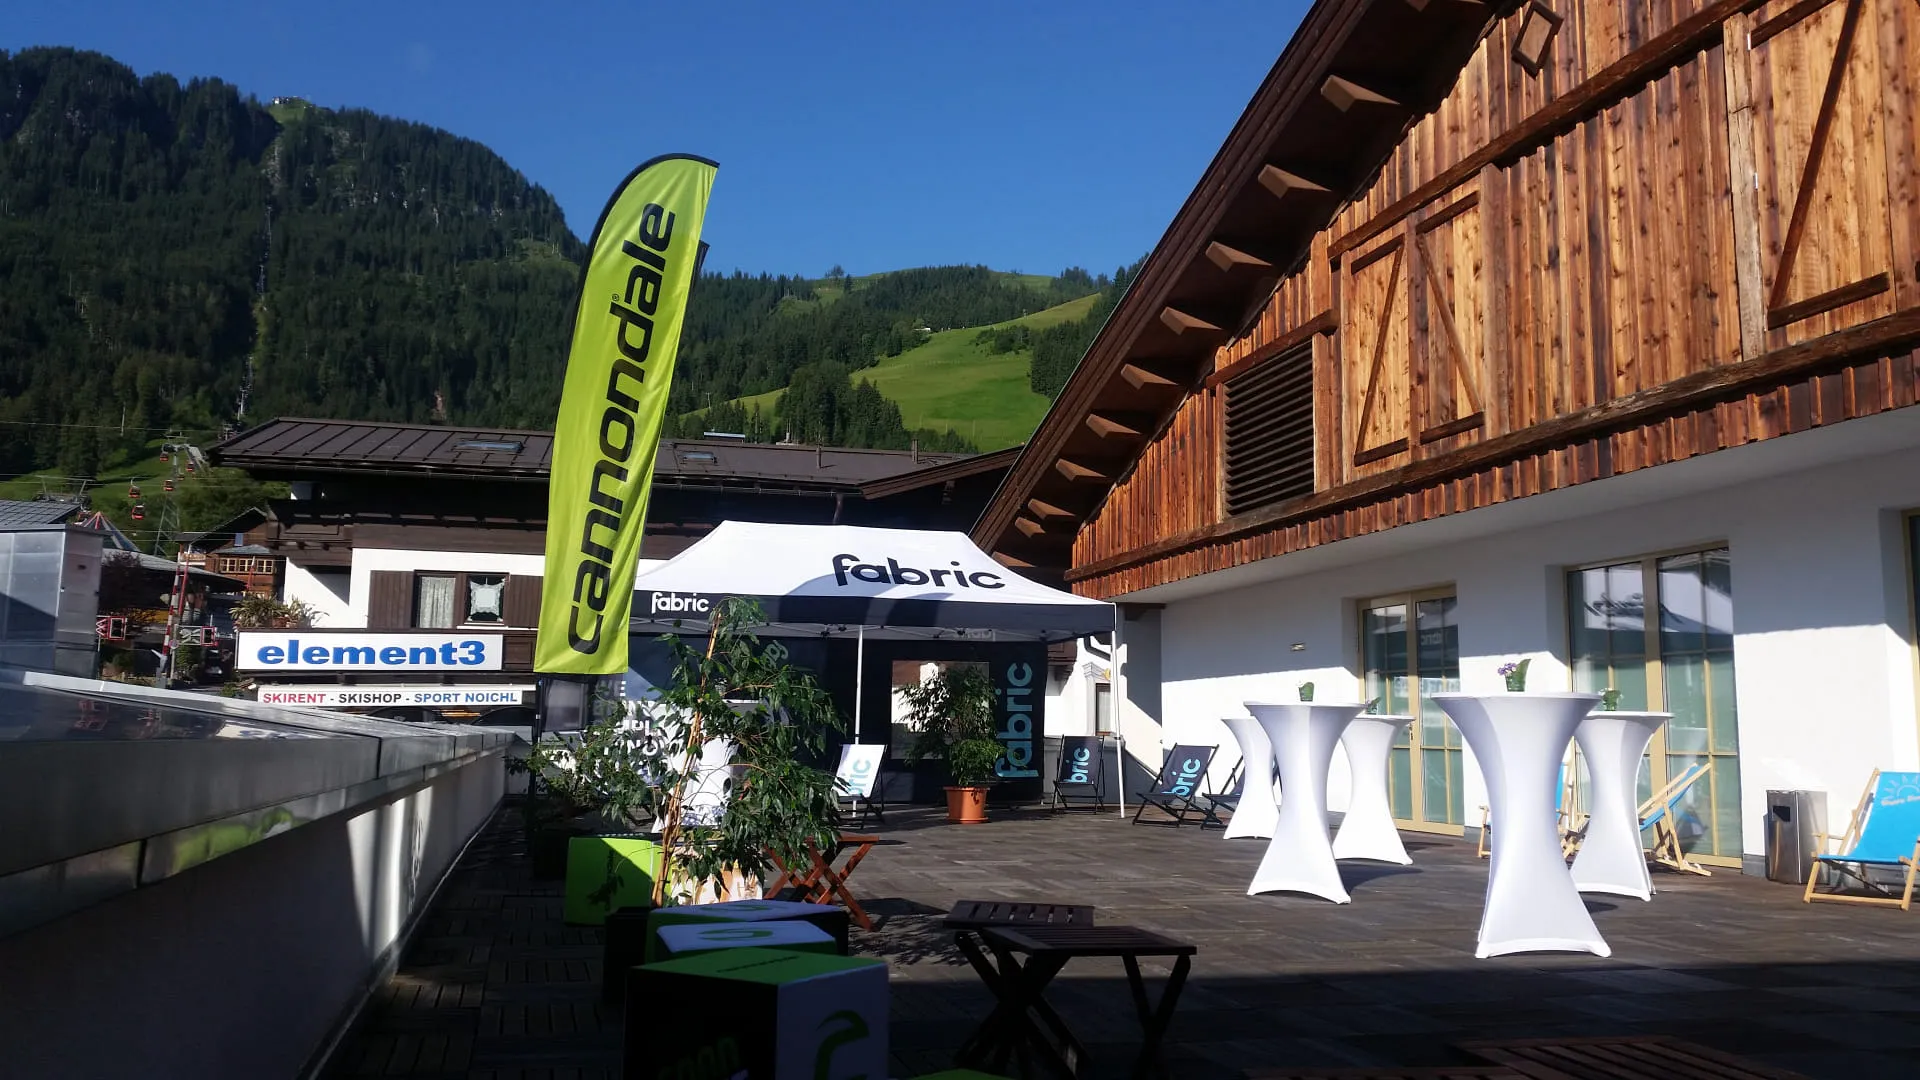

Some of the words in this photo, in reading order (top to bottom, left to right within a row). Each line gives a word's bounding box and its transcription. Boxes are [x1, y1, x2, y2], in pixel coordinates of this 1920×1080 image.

[567, 202, 677, 656] cannondale
[831, 553, 1006, 590] fabric
[651, 591, 710, 615] fabric
[256, 639, 486, 666] element3
[262, 692, 327, 704] SKIRENT
[338, 692, 402, 704] SKISHOP
[413, 692, 461, 704] SPORT
[465, 692, 518, 703] NOICHL
[994, 661, 1040, 778] fabric
